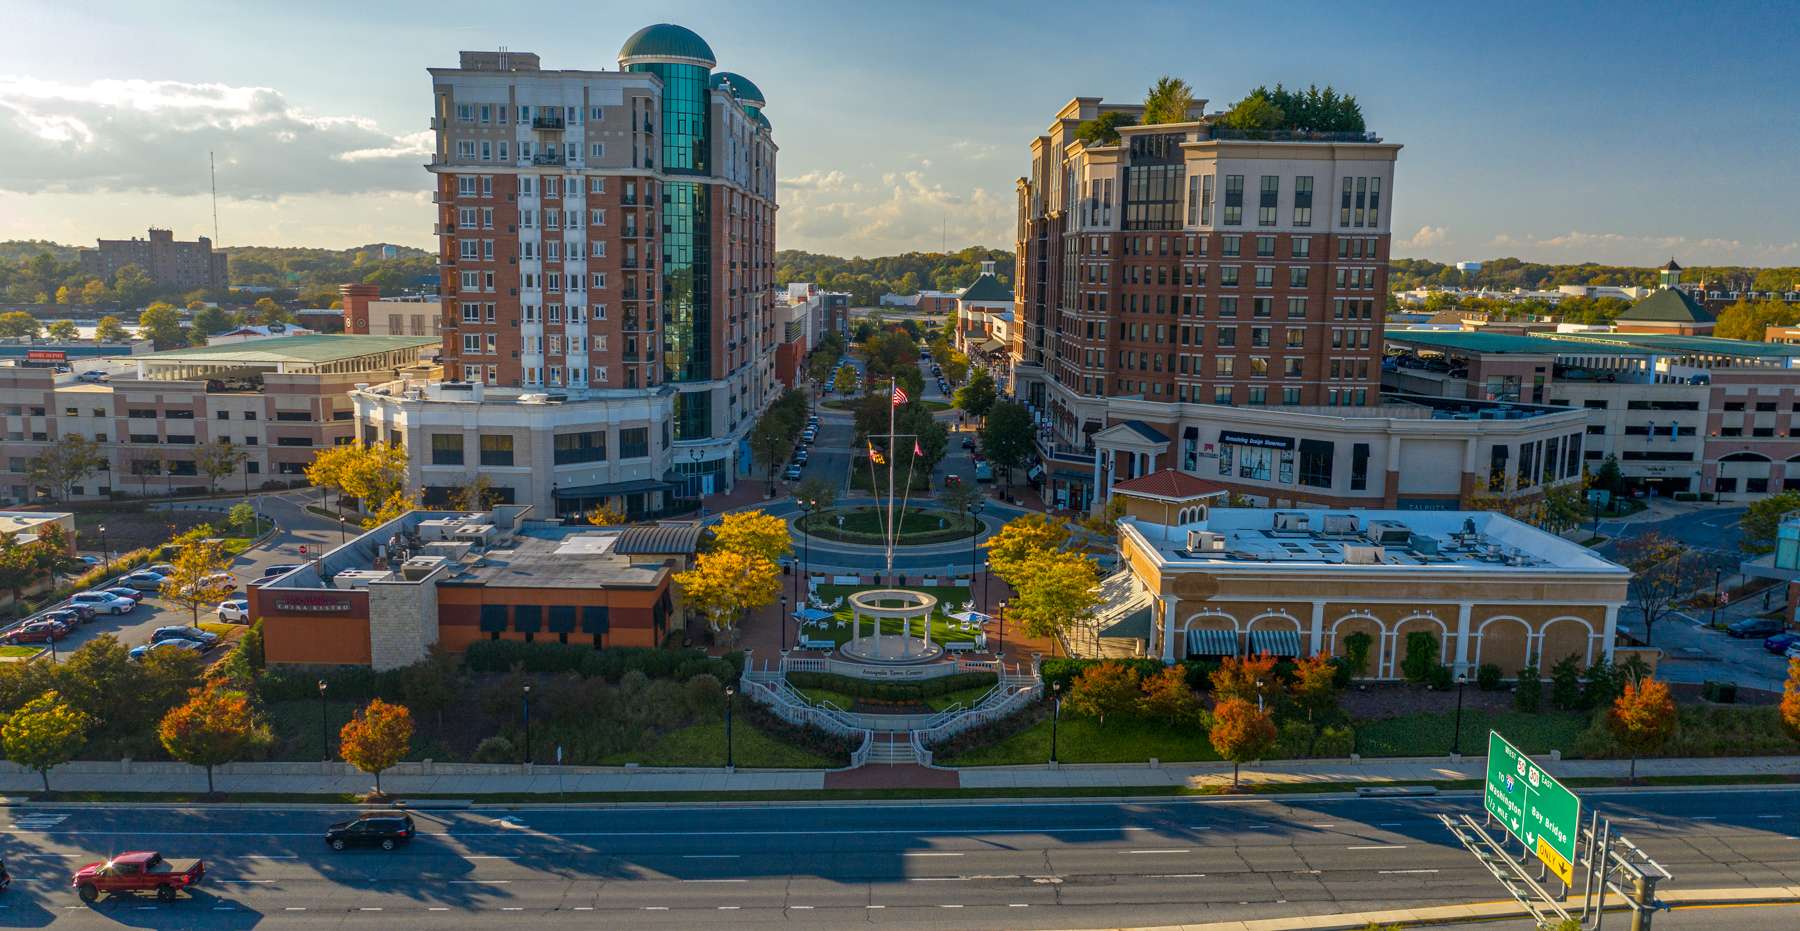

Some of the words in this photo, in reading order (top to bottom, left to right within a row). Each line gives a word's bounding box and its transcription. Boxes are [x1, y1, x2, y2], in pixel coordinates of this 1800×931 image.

[1498, 771, 1504, 782] TO
[1505, 746, 1516, 760] WEST
[1530, 769, 1539, 784] 301
[1541, 774, 1552, 789] EAST
[1487, 795, 1495, 811] 1/2
[1497, 805, 1508, 821] MILE
[1489, 782, 1521, 817] Washington
[1531, 806, 1543, 824] Bay
[1545, 817, 1566, 844] Bridge
[1540, 844, 1556, 865] ONLY
